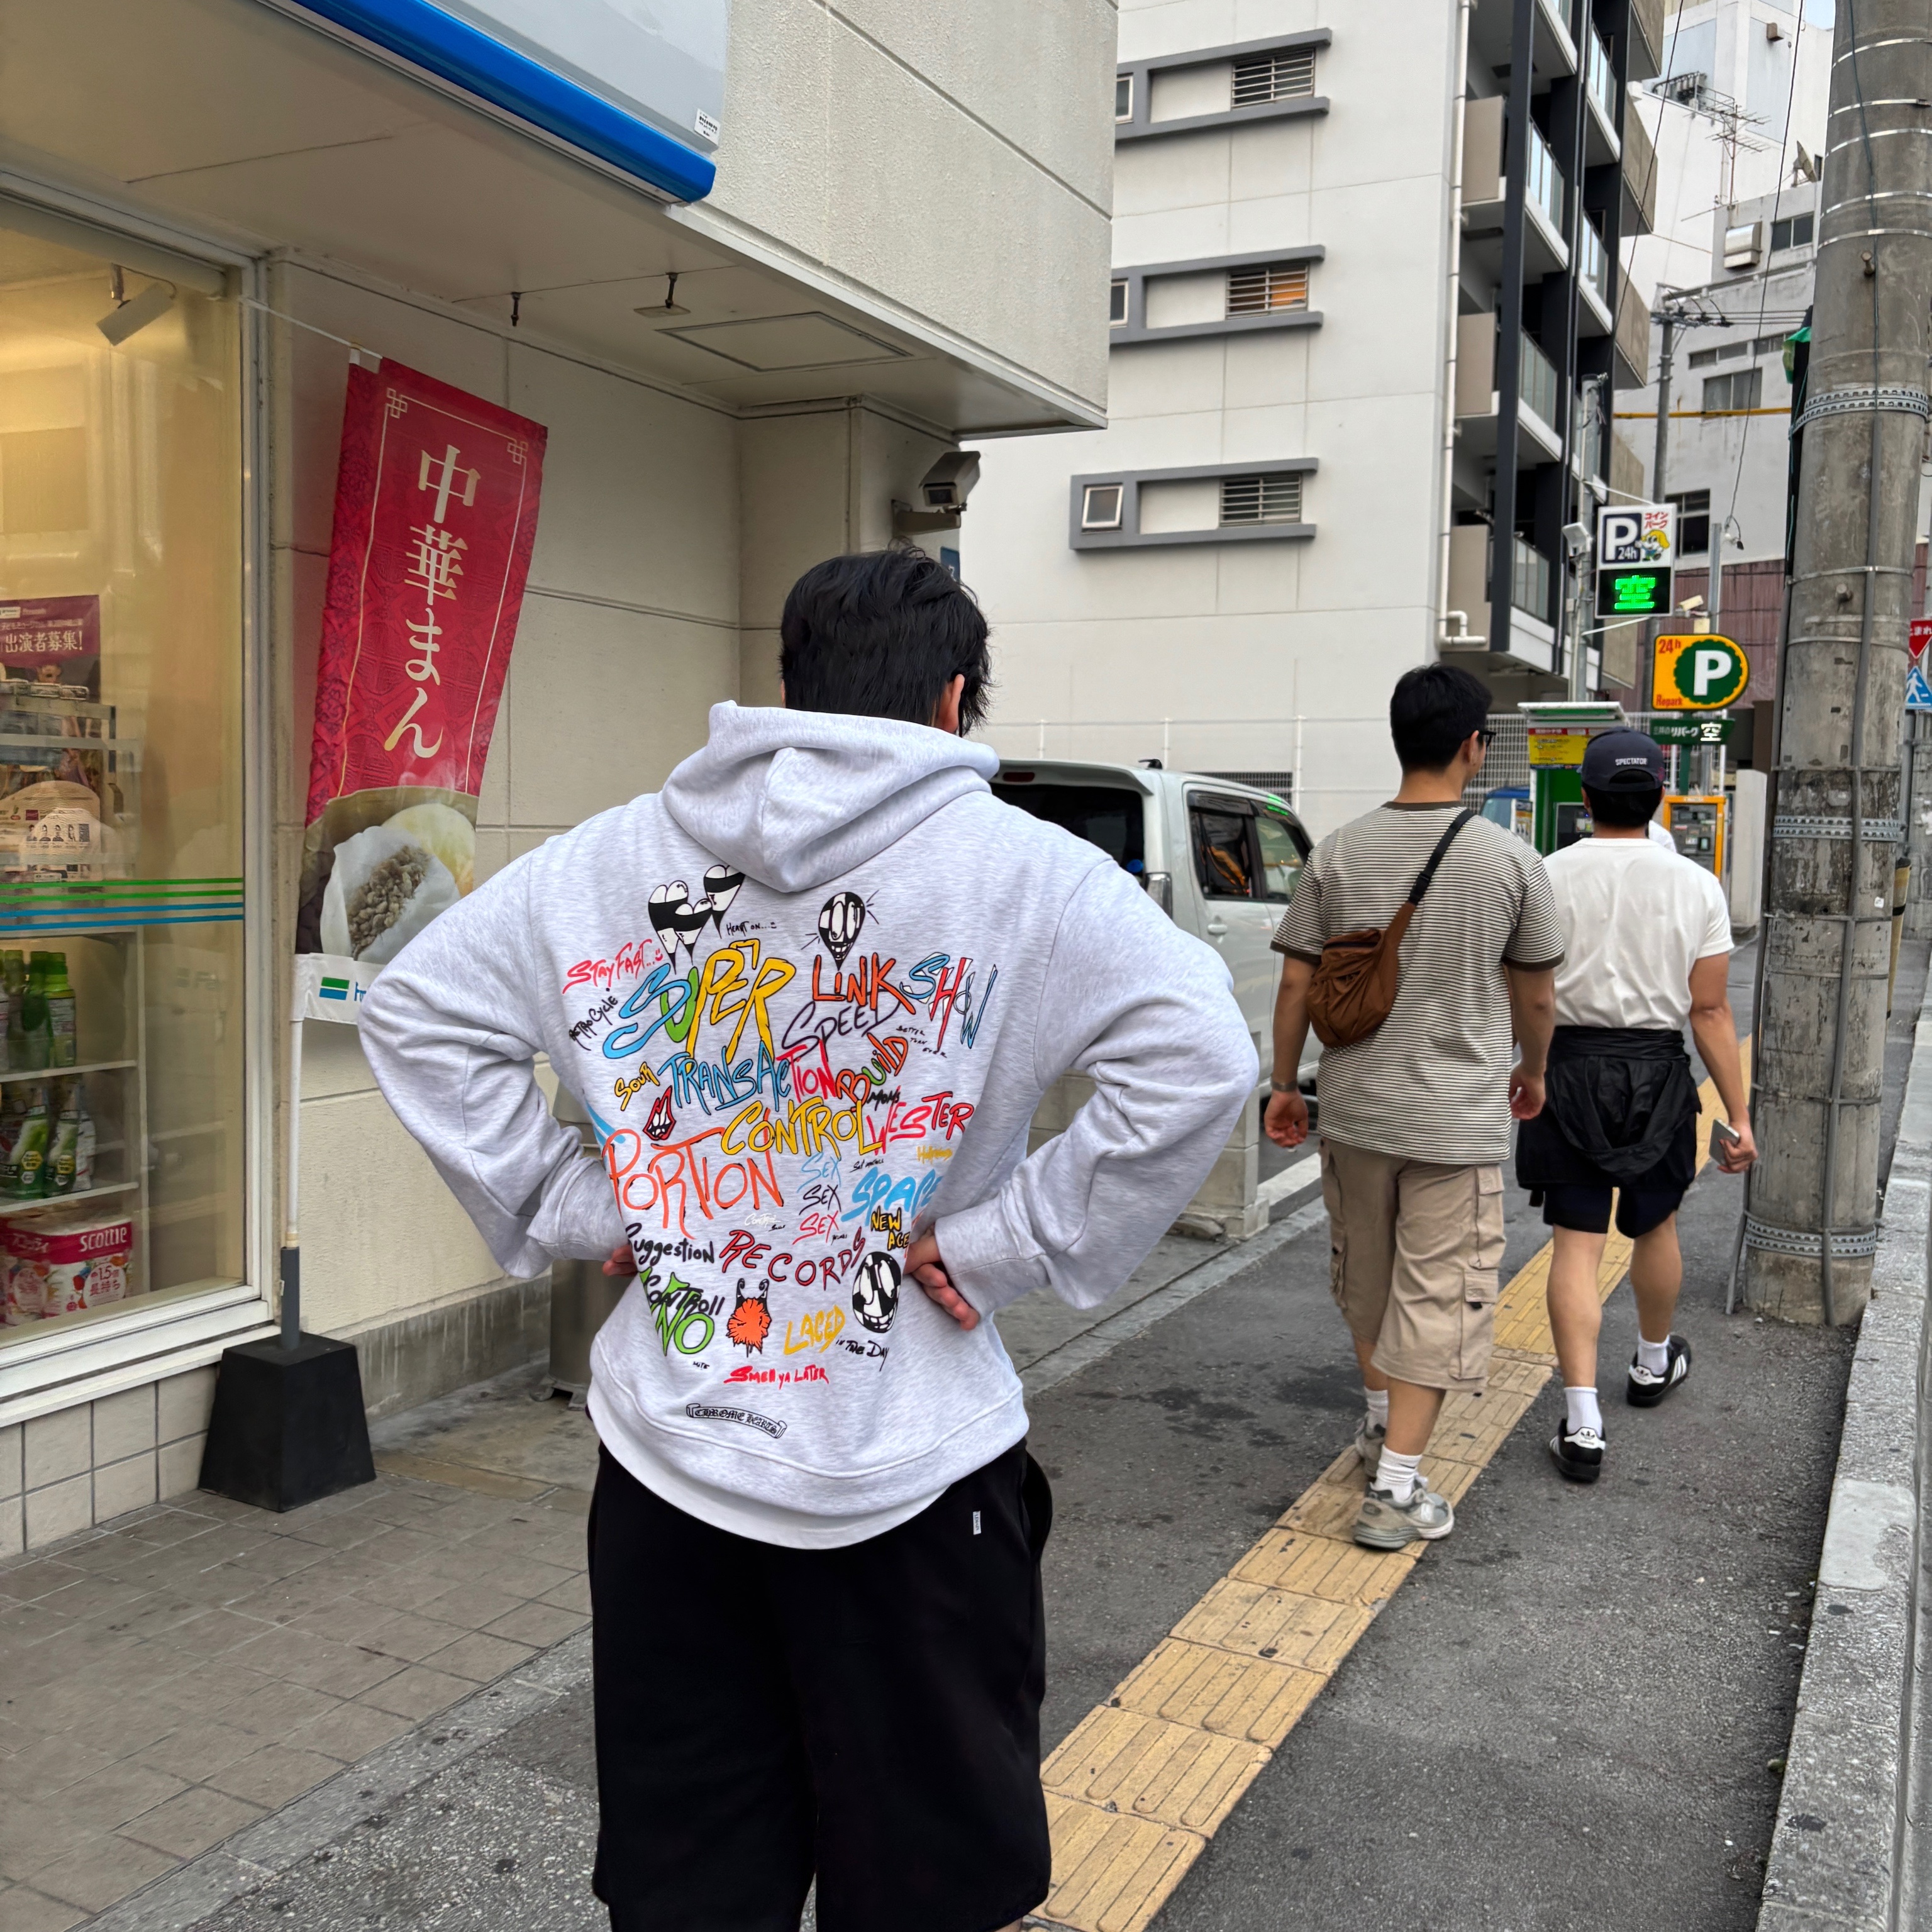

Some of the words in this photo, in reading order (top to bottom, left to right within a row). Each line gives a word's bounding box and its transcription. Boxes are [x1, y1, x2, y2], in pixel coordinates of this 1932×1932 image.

[1644, 511, 1668, 521] コイン
[1605, 516, 1638, 561] P
[1618, 546, 1638, 560] 24h
[384, 444, 481, 758] 中華まん
[1614, 574, 1657, 610] 空
[1658, 638, 1682, 654] 24h
[1693, 650, 1732, 696] P
[1700, 722, 1722, 742] 空
[1615, 757, 1648, 766] SPECTATOR
[602, 938, 797, 1073] SUPER
[782, 989, 902, 1063] SPEED
[721, 1099, 884, 1162] CONTROL
[796, 1152, 842, 1194] SEX
[799, 1184, 841, 1216] SEX
[792, 1210, 840, 1246] SEX
[870, 1206, 902, 1231] NEW
[79, 1226, 128, 1252] scottie
[719, 1226, 865, 1291] RECORDS
